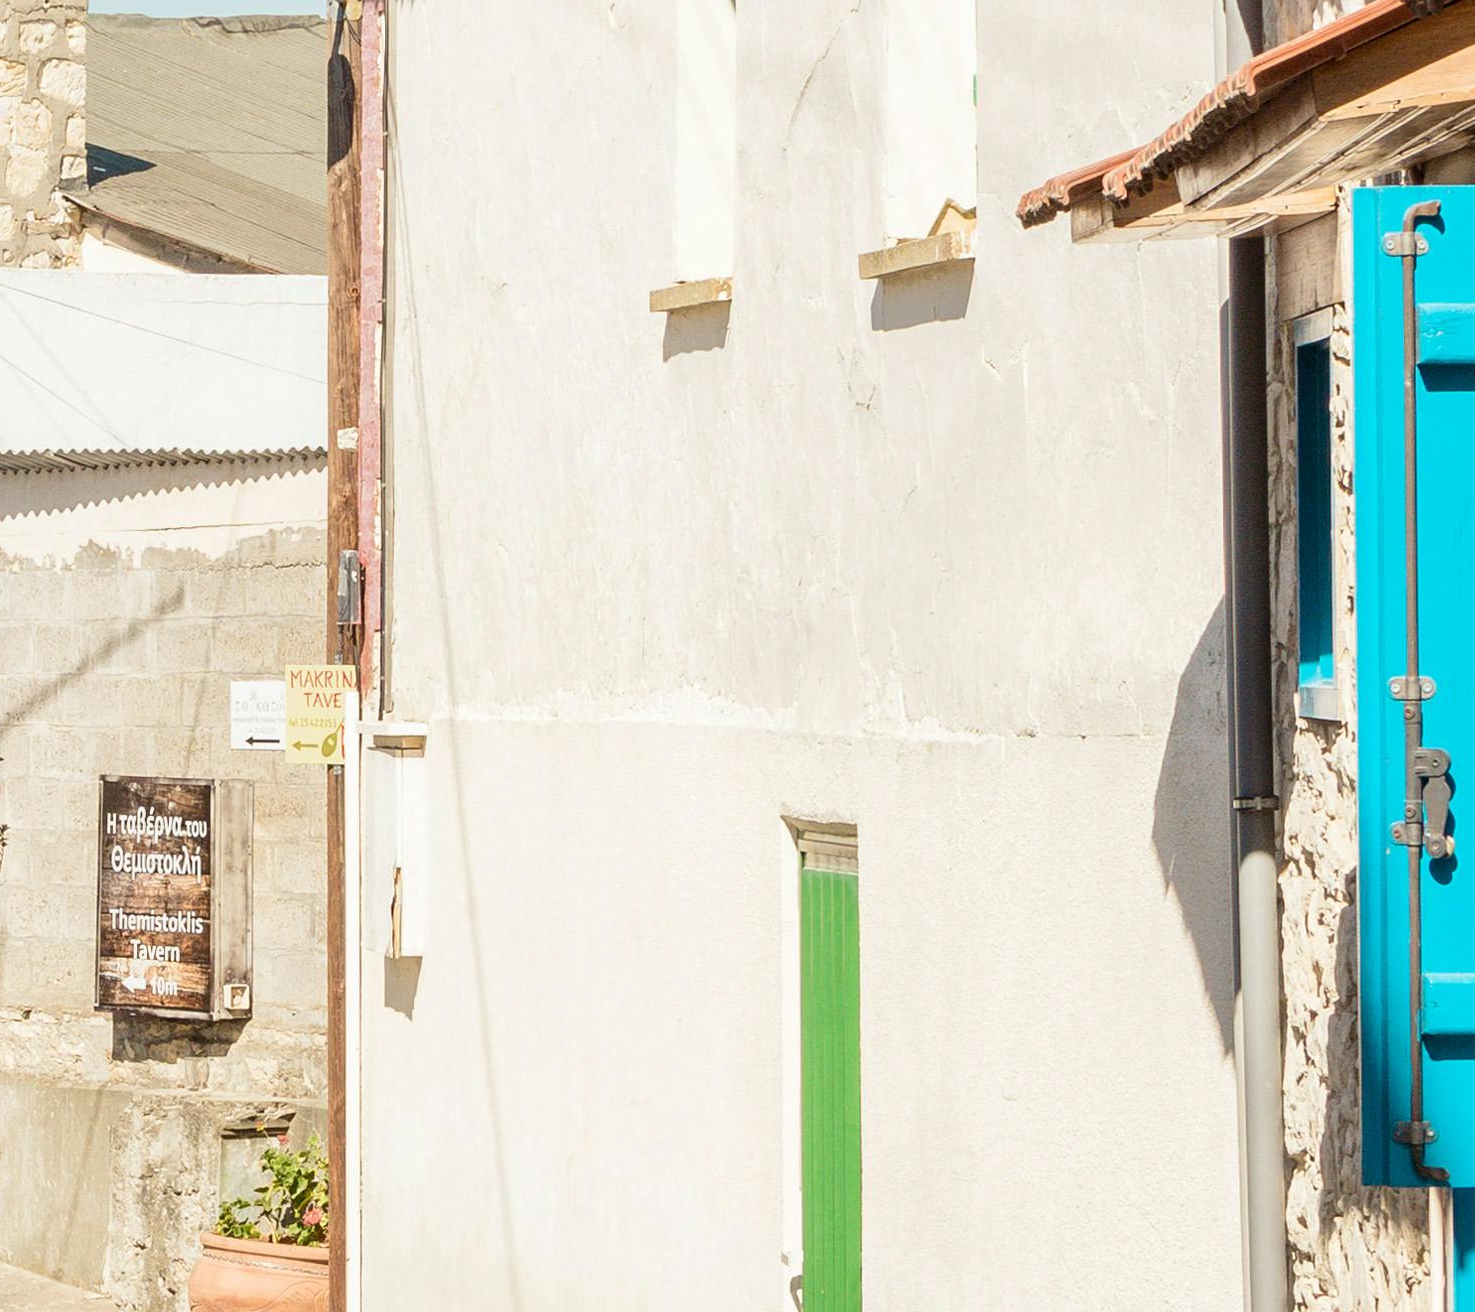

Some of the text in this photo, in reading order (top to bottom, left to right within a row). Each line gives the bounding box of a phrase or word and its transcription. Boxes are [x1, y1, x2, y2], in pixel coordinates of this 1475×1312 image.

[303, 692, 343, 708] TAVE
[119, 806, 183, 843] ταβέρνα
[184, 820, 208, 838] του
[111, 845, 202, 884] Θεμιστοκλή
[109, 908, 204, 934] Themistoklis
[130, 939, 180, 962] Tavern
[150, 975, 178, 996] 10m
